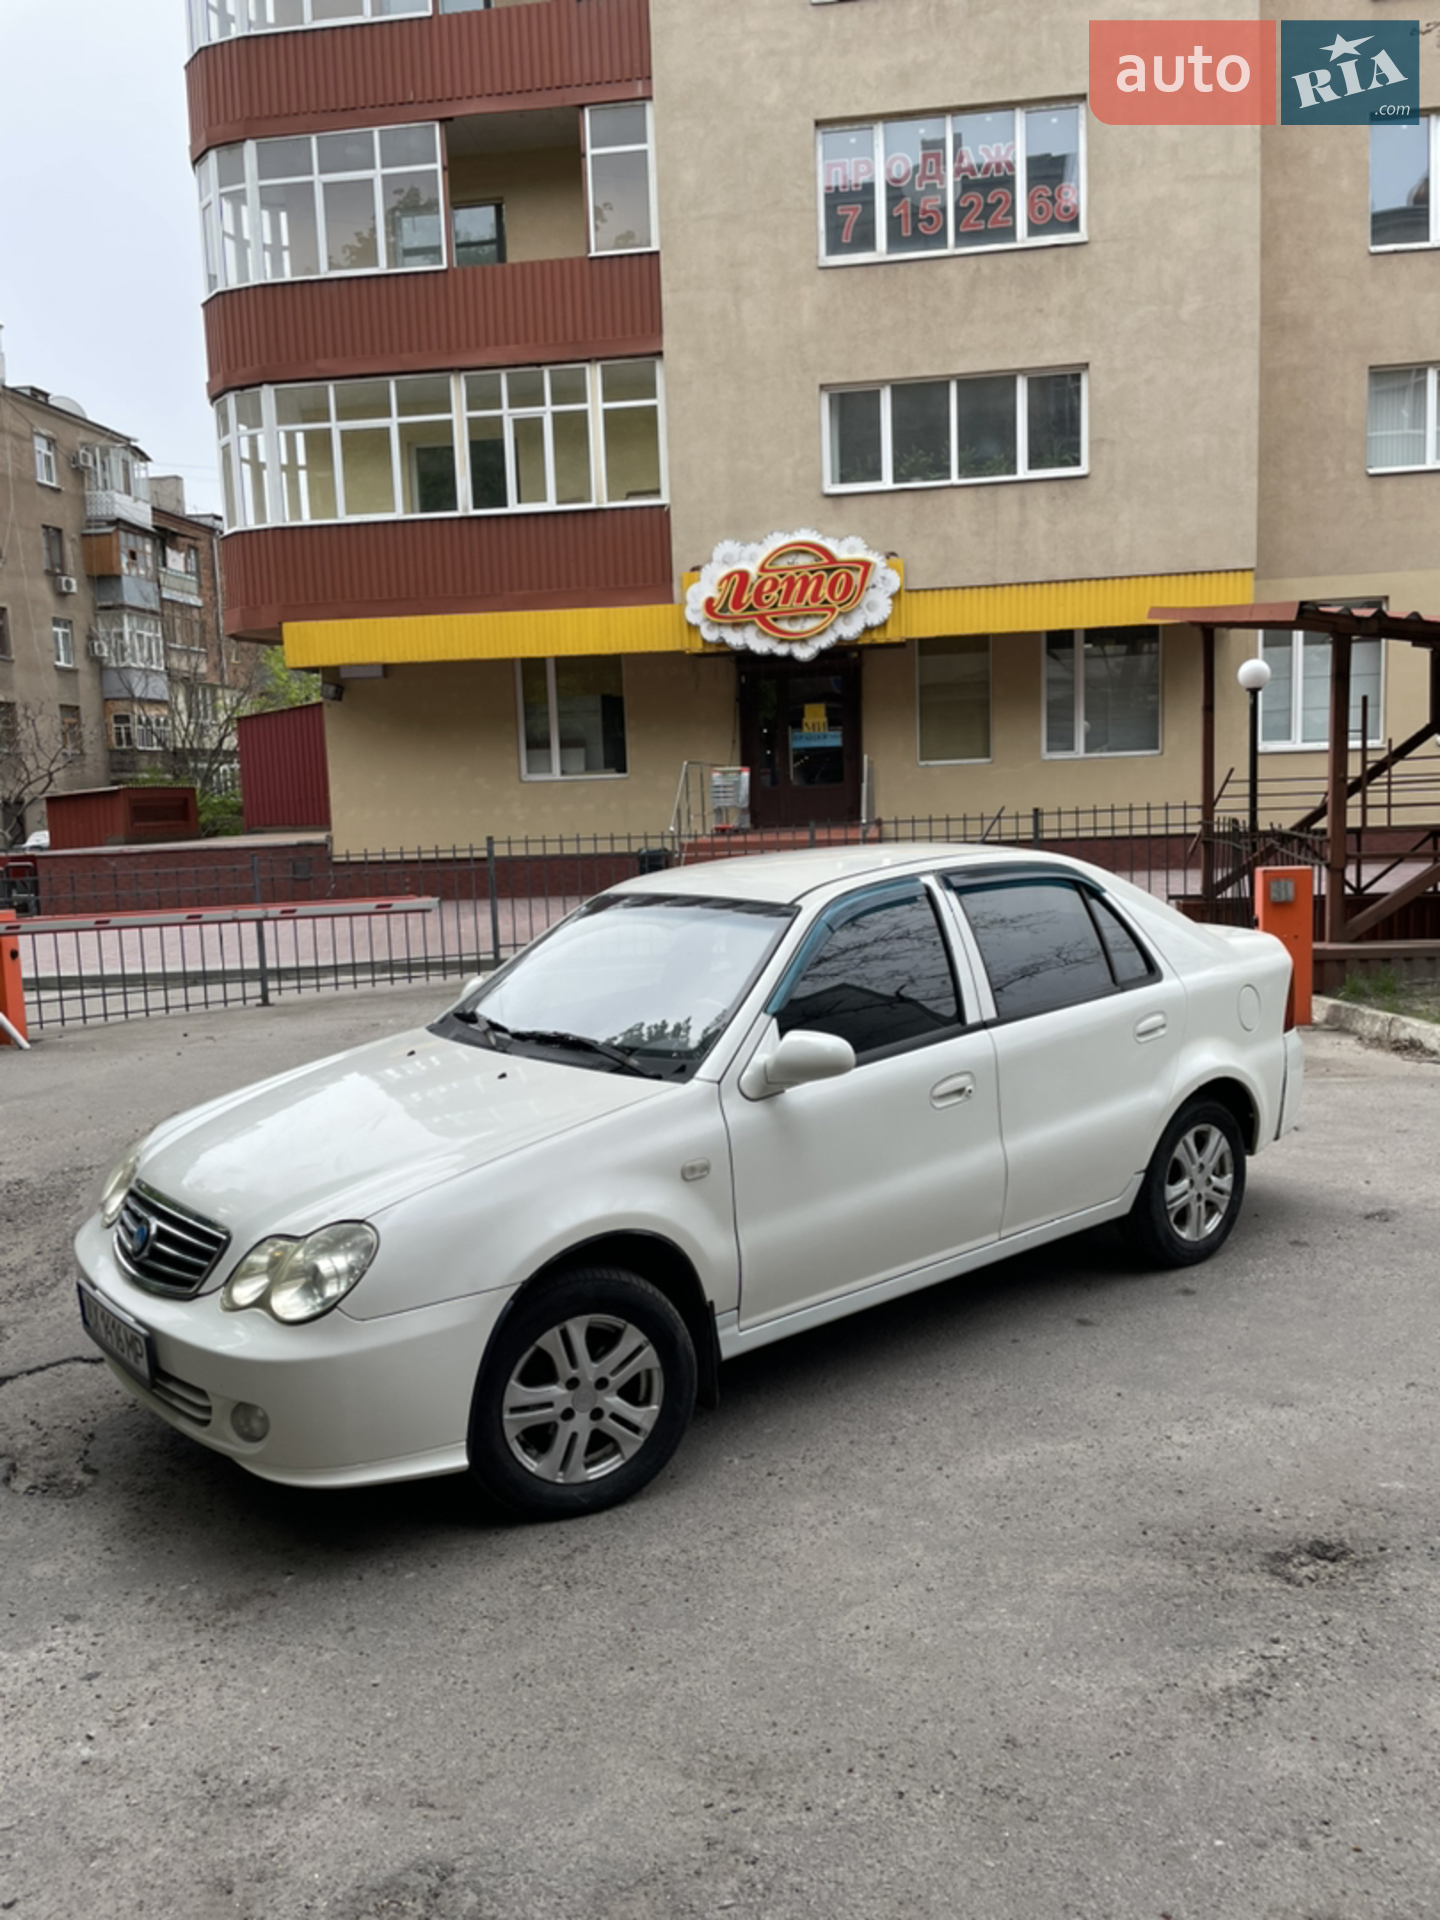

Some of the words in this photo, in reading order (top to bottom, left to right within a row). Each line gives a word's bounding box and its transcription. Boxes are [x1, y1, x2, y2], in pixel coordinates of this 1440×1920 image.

[837, 204, 862, 243] 7
[892, 196, 943, 237] 15
[959, 188, 1012, 232] 22
[1028, 184, 1079, 225] 68
